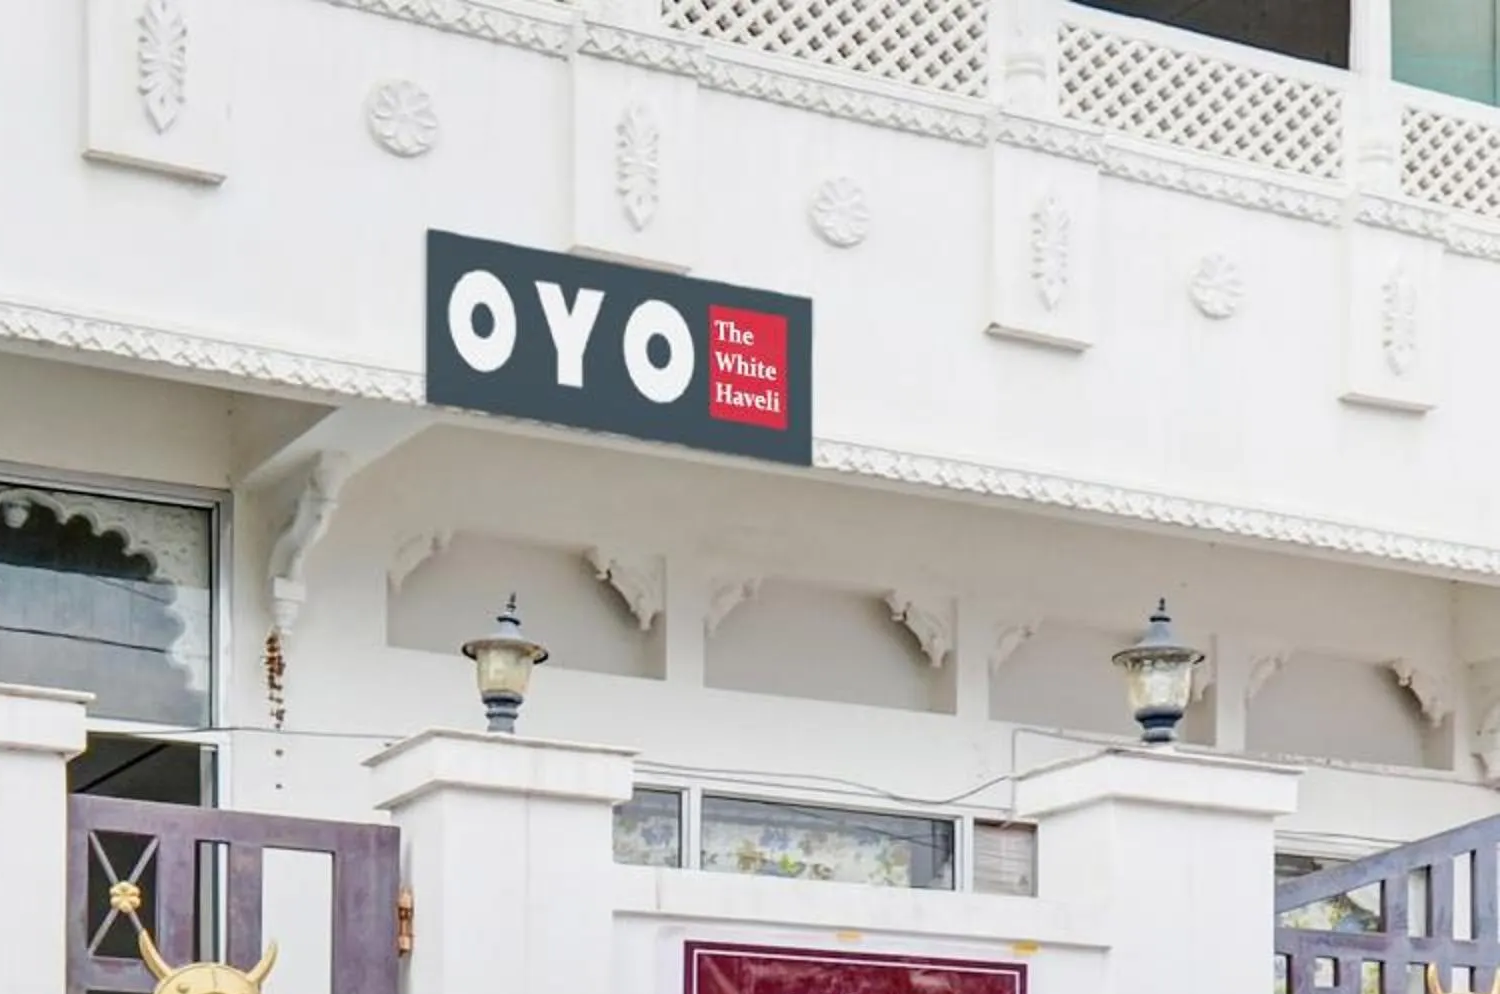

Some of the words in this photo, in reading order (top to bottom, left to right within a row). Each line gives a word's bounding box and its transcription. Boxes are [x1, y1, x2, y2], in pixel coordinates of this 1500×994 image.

[448, 269, 695, 404] OYO
[714, 319, 755, 346] The
[715, 351, 778, 381] White
[716, 382, 781, 413] Haveli
